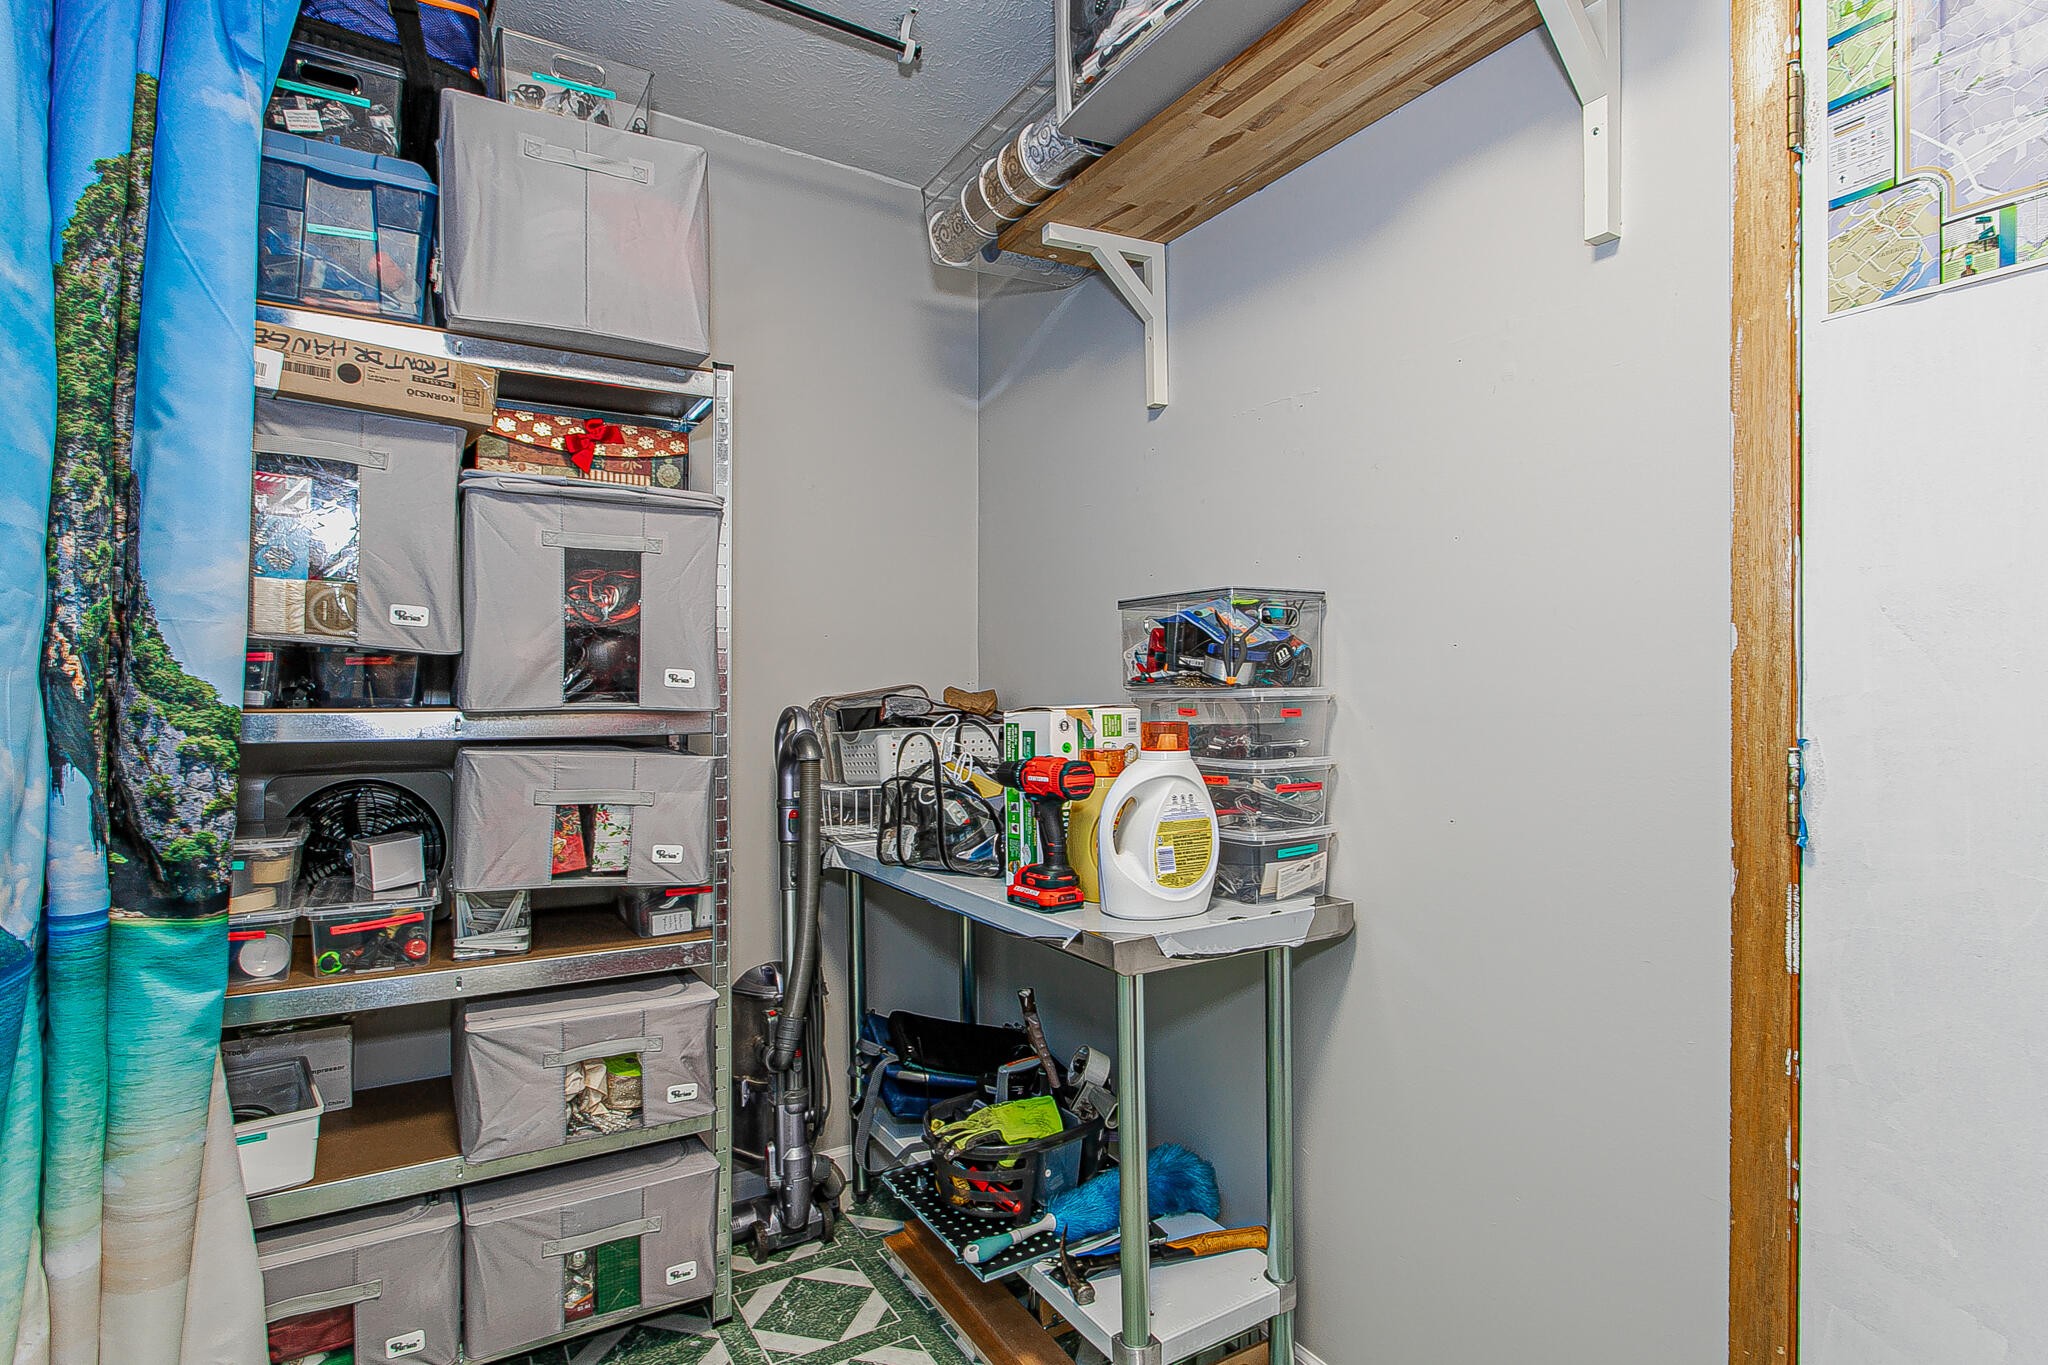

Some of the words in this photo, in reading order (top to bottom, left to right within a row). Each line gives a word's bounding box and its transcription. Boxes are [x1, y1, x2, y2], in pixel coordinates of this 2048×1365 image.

[353, 346, 384, 365] DR
[384, 354, 450, 378] FRONT
[406, 388, 456, 403] KORNSJÖ
